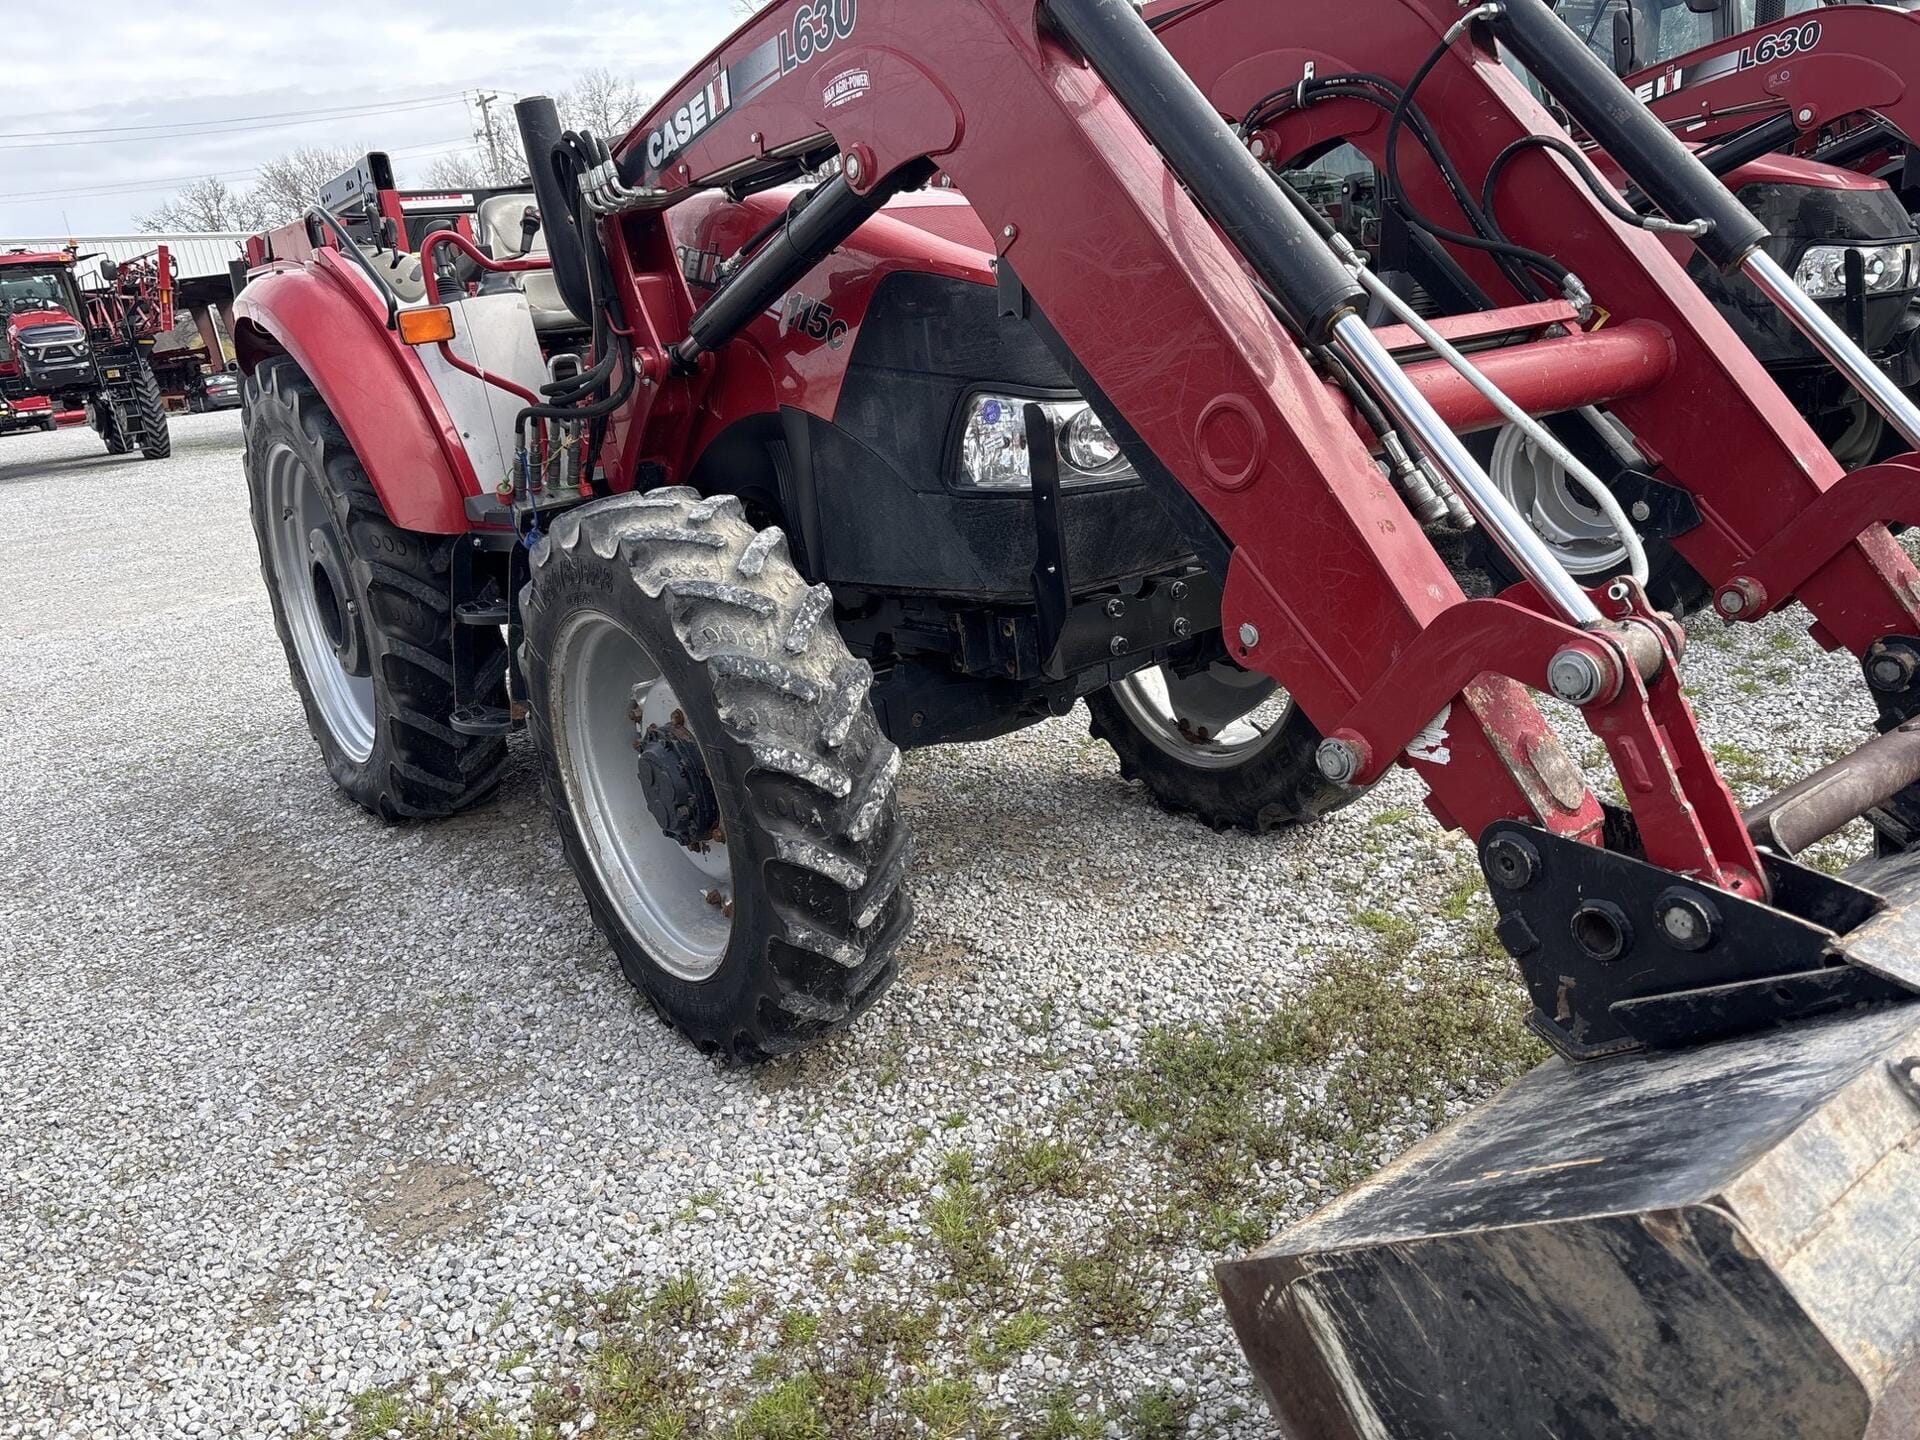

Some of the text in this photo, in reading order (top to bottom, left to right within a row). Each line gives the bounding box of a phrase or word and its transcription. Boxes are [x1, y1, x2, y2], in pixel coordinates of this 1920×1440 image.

[780, 0, 857, 76] L630
[1739, 20, 1822, 71] L630
[648, 90, 707, 168] CASE
